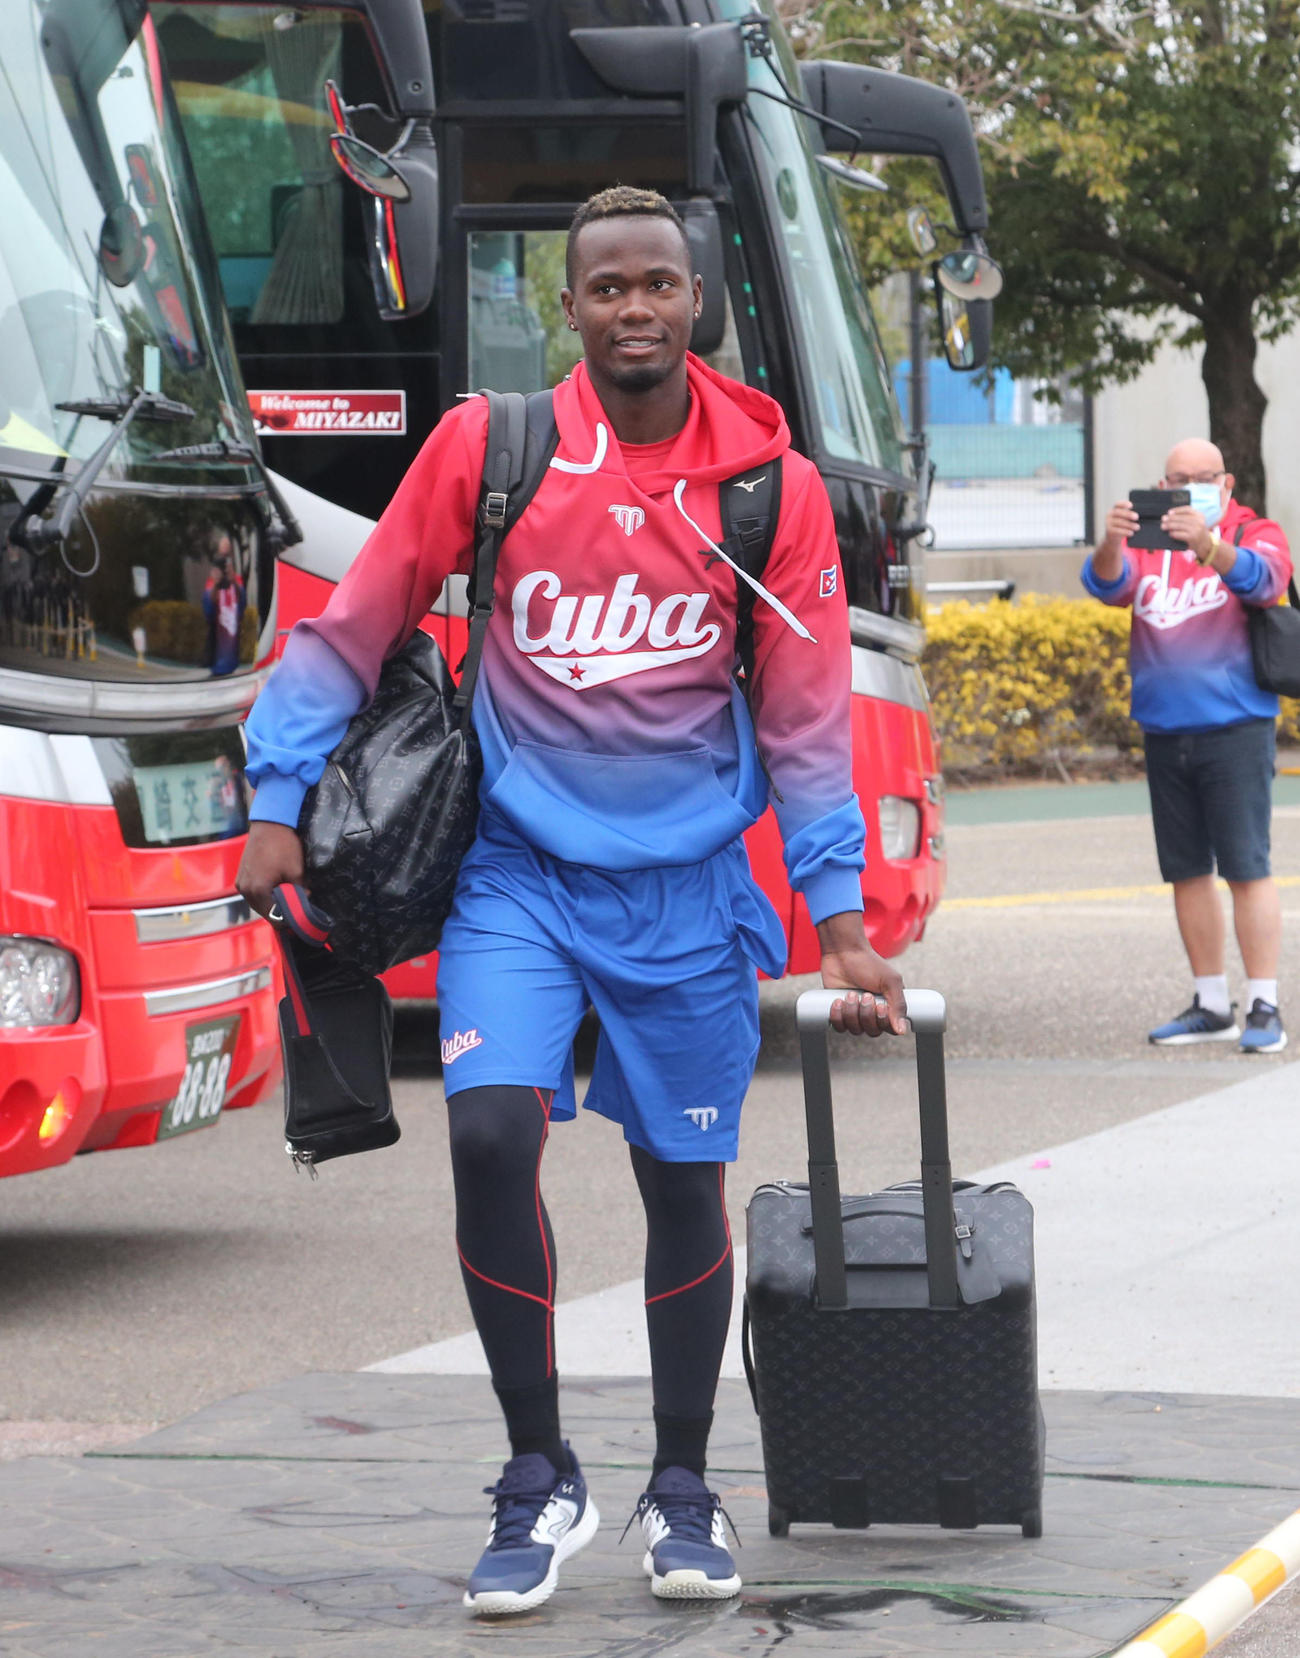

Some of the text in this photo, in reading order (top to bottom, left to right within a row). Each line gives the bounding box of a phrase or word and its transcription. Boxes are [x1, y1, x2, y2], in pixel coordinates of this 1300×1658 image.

[260, 395, 350, 410] Welcome to
[293, 411, 401, 429] MIYAZAKI
[512, 570, 721, 660] Cuba
